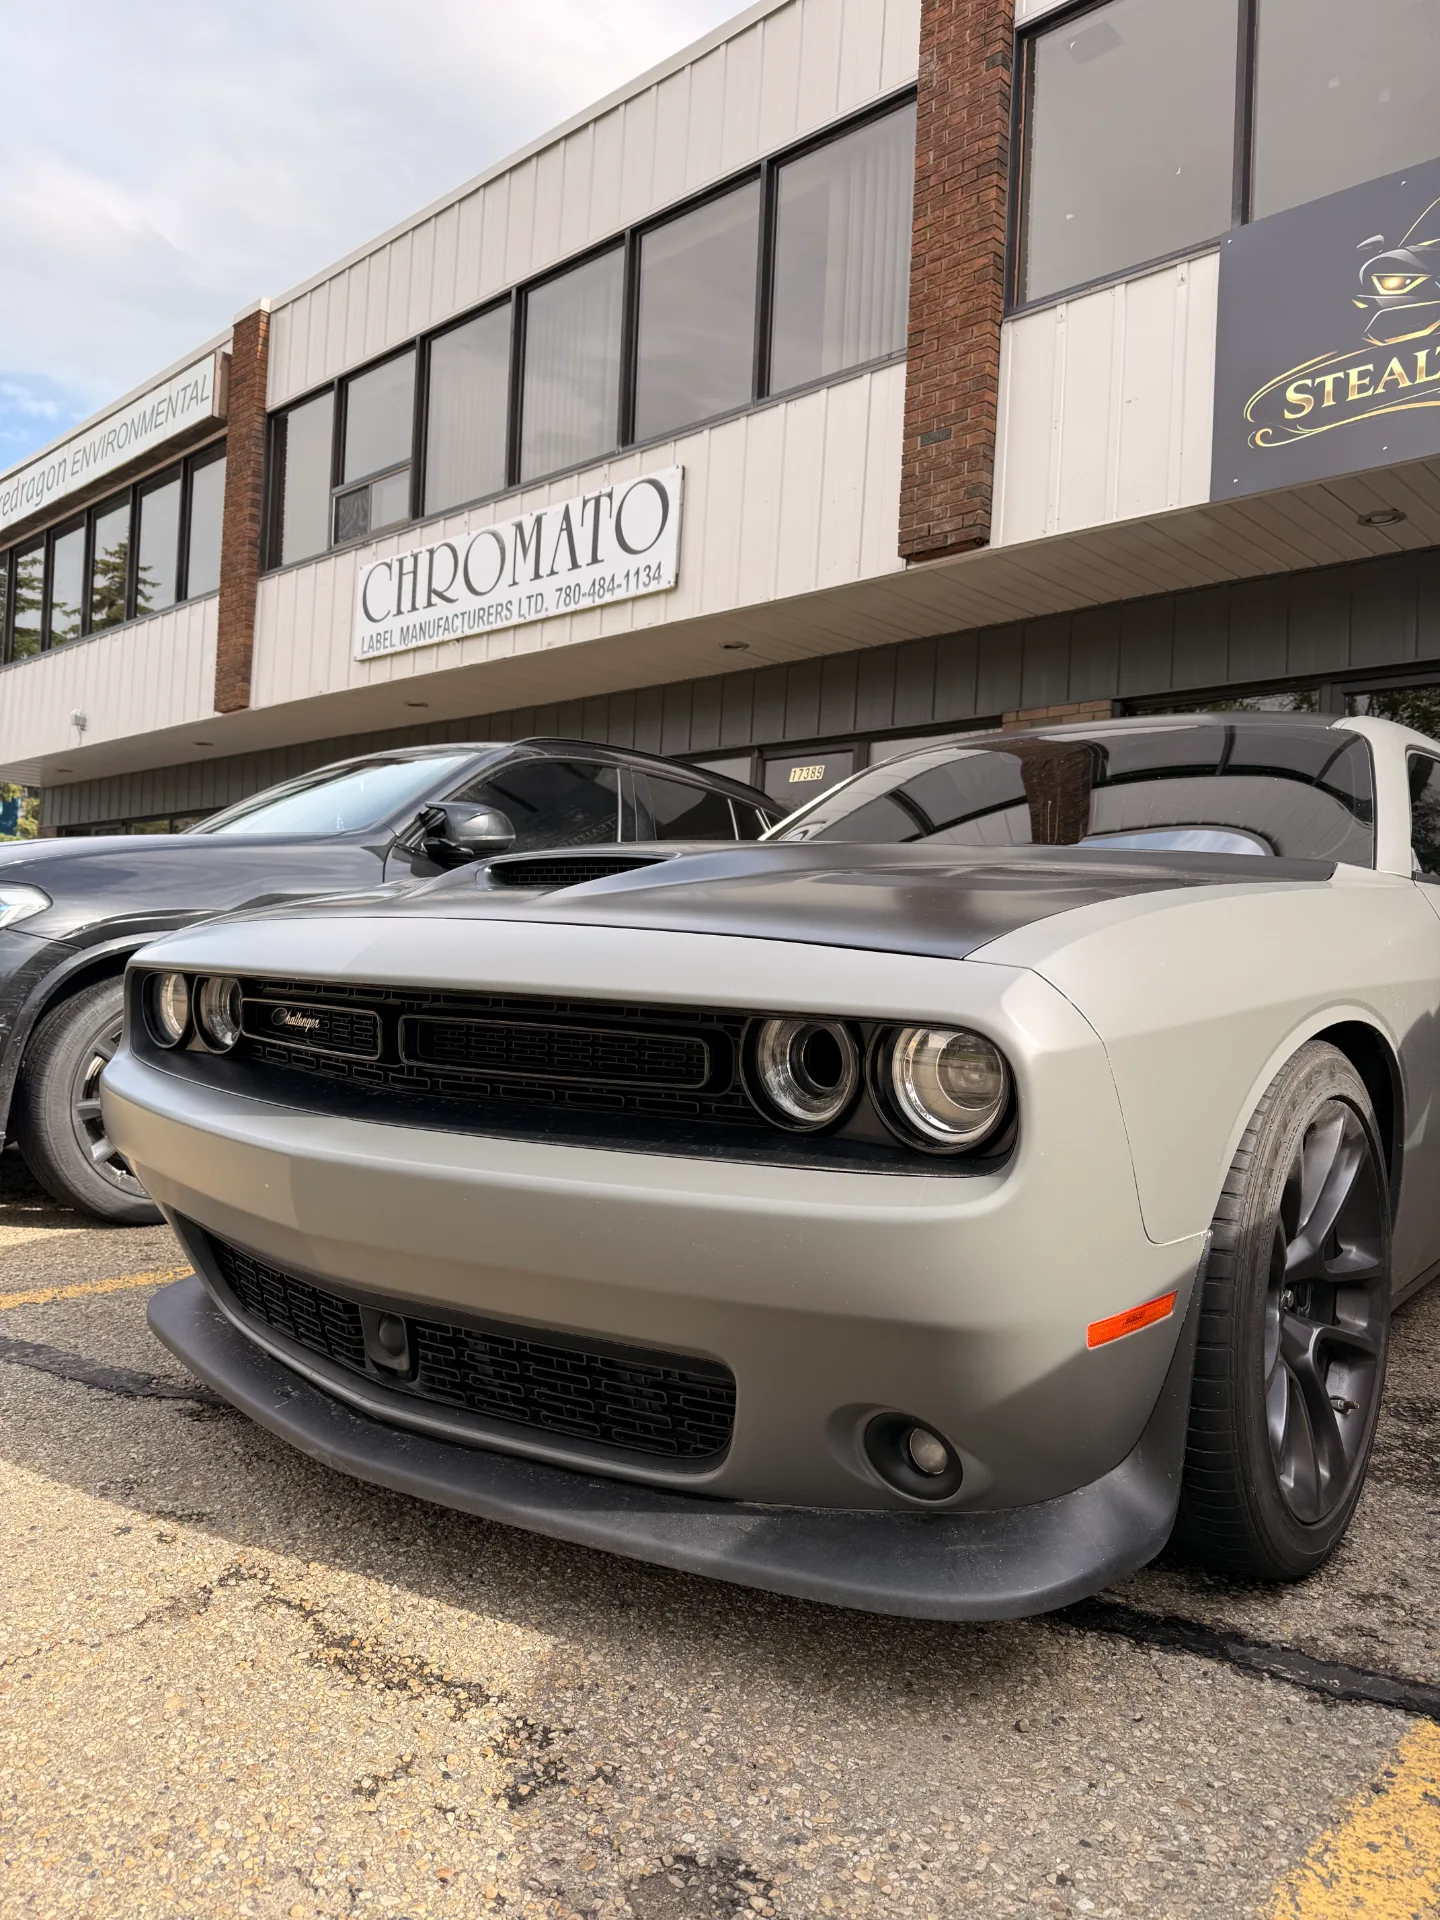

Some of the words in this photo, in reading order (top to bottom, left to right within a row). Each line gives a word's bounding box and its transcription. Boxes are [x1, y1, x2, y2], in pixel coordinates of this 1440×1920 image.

[1284, 346, 1440, 419] STEAL
[0, 457, 67, 516] edragon
[71, 374, 210, 477] ENVIRONMENTAL
[362, 477, 669, 623] CHROMATO
[361, 626, 396, 655] LABEL
[400, 600, 513, 646] MANUFACTURERS
[518, 592, 548, 619] LTD.
[555, 561, 662, 609] 780-484-1134
[792, 766, 824, 781] 17389
[271, 1007, 320, 1032] Challenger
